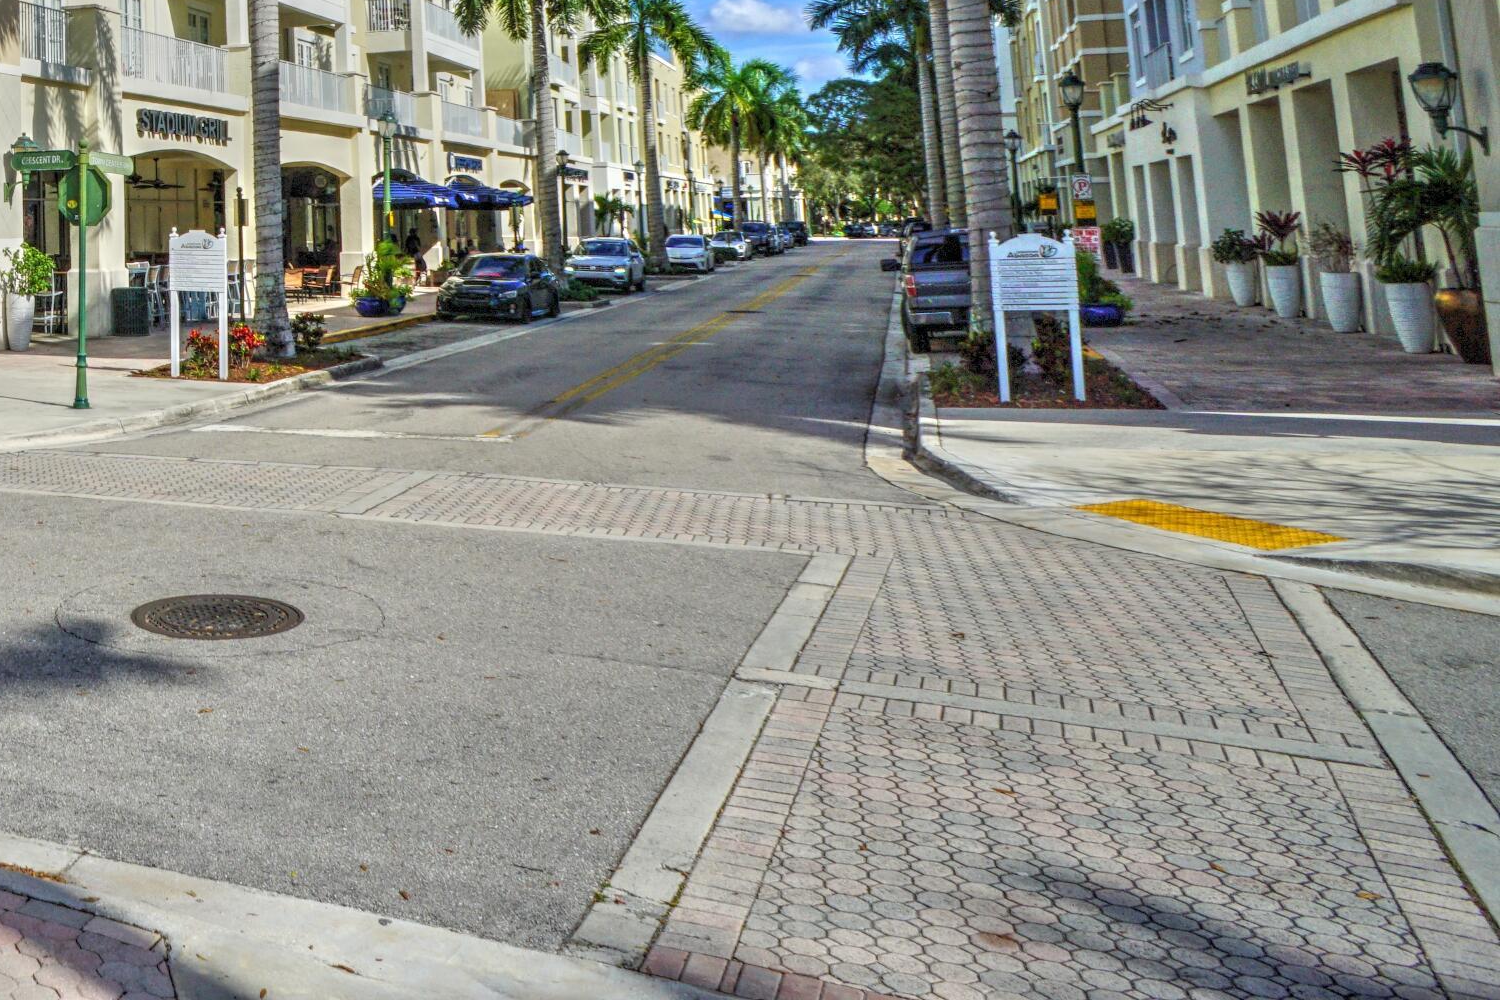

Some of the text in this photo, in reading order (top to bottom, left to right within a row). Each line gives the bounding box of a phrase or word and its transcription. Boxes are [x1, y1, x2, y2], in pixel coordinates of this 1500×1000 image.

[138, 108, 232, 141] STADIUM GRILL
[21, 155, 51, 165] CRESCENT
